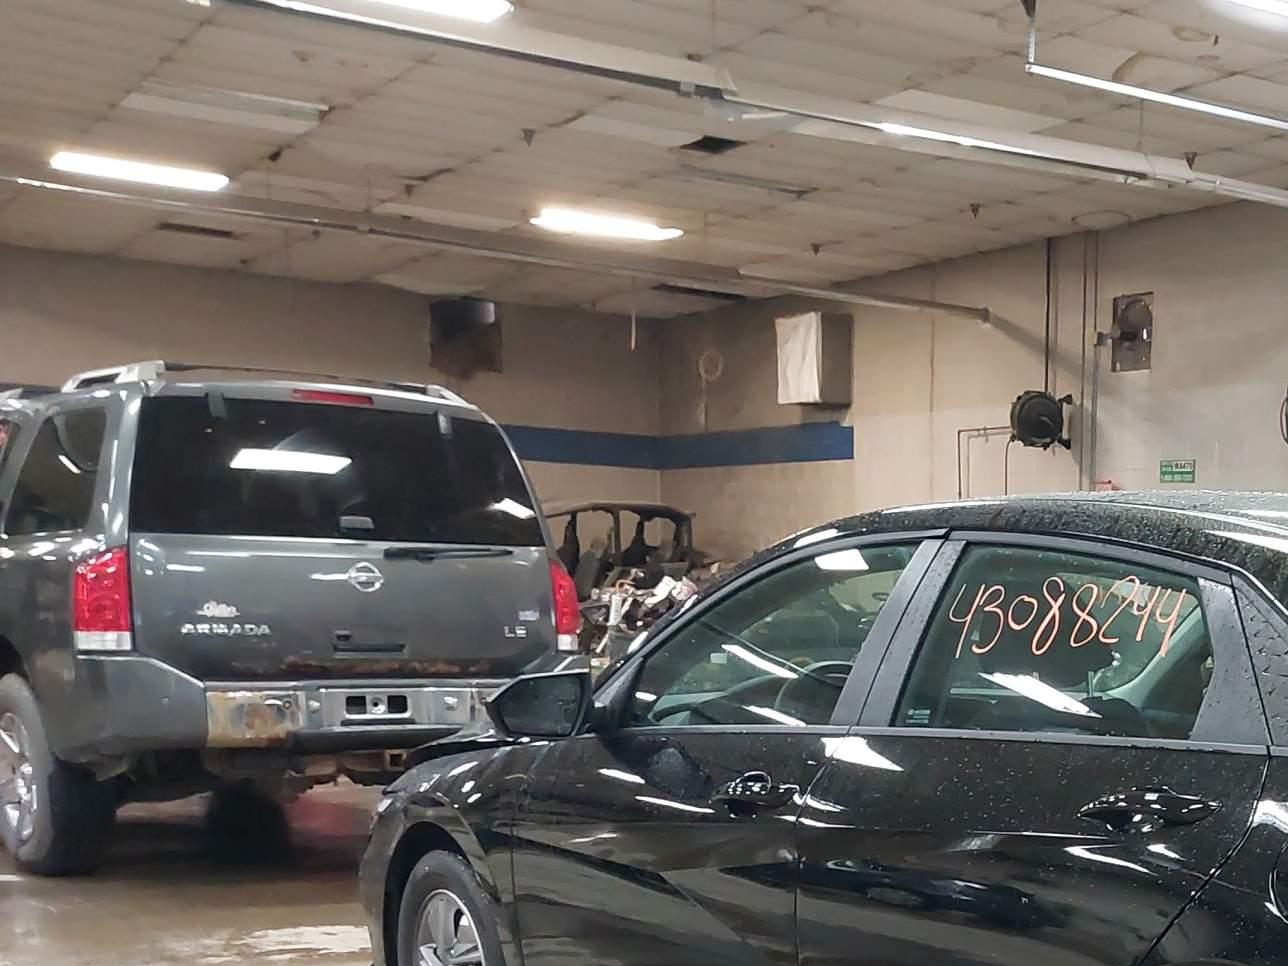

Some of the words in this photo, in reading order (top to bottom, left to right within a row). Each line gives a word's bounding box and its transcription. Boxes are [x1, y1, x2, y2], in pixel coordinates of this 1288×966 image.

[949, 575, 1187, 659] 43088244
[181, 623, 270, 636] ARMADA
[504, 625, 527, 638] LE
